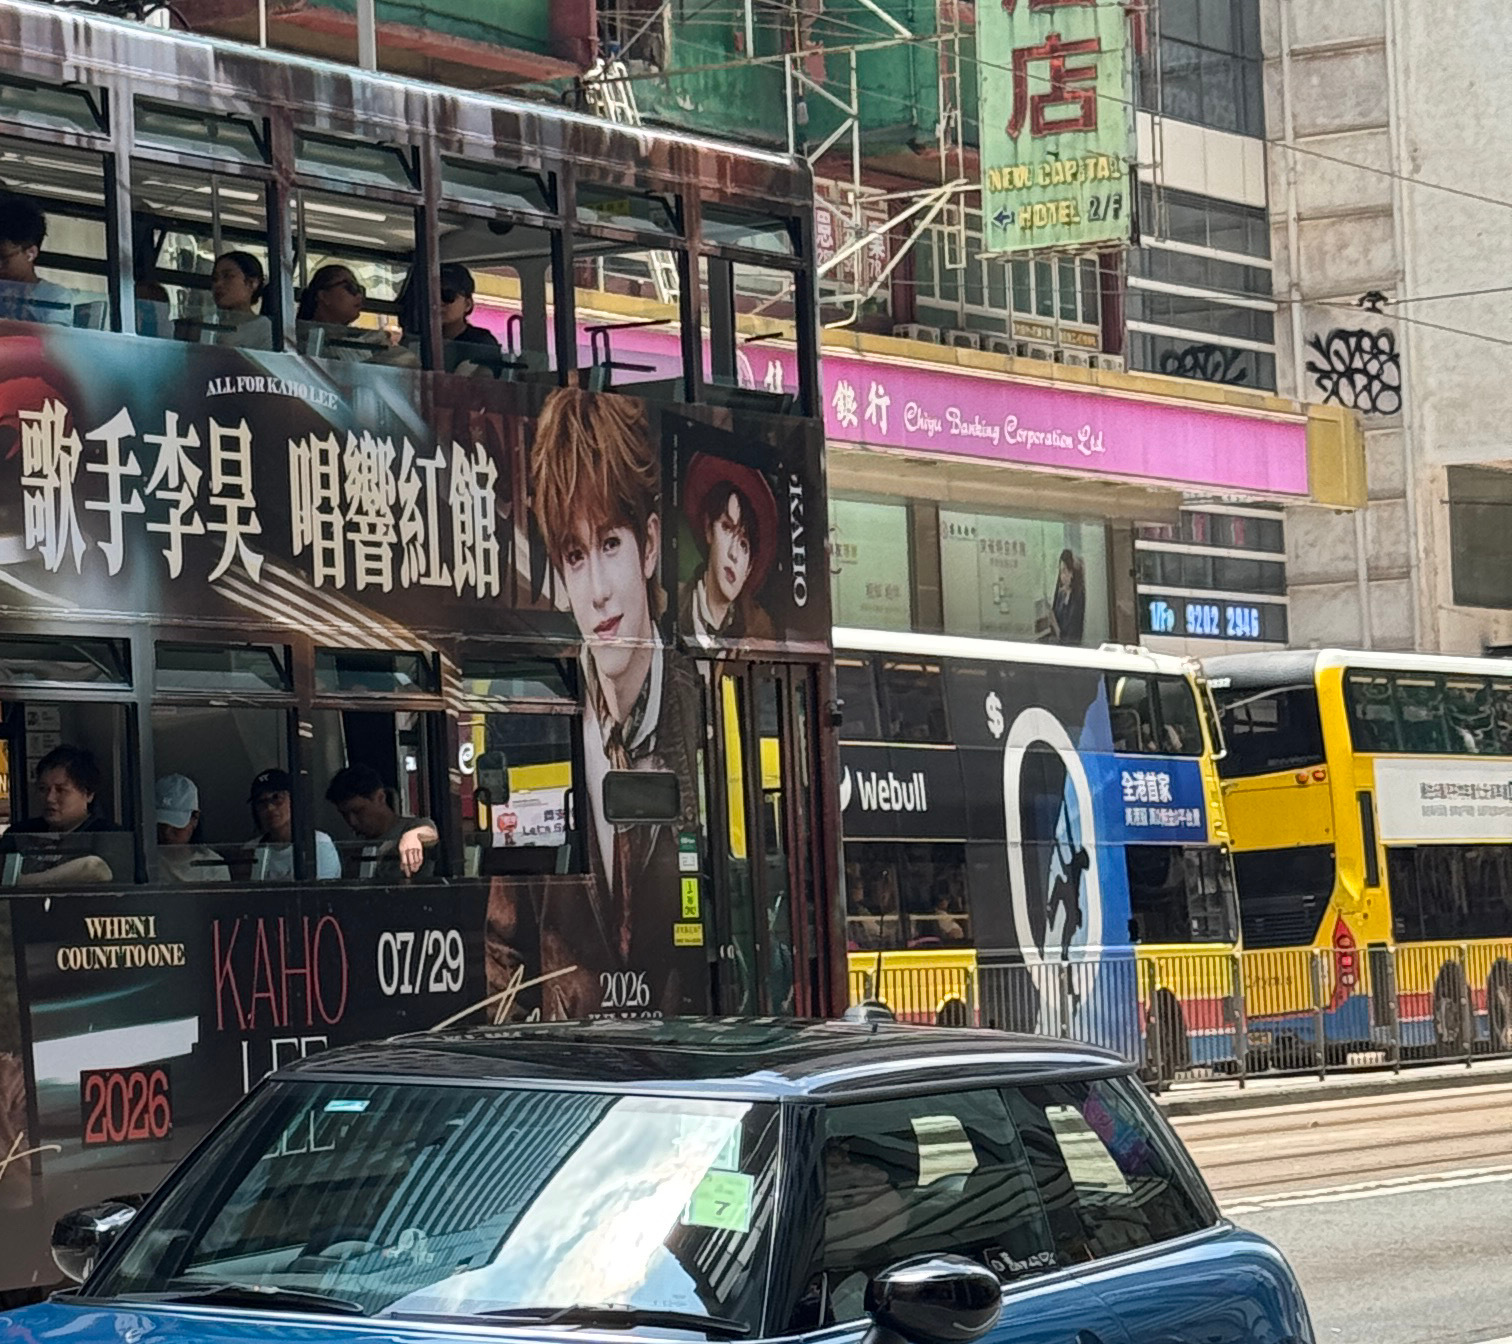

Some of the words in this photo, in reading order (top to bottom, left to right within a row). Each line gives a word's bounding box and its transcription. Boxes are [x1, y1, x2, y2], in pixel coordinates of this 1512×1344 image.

[989, 165, 1032, 190] NEW
[1018, 201, 1081, 229] HOTEL
[1089, 193, 1122, 221] 2/F
[206, 377, 236, 397] ALL
[236, 375, 265, 393] FOR
[266, 376, 307, 399] KAHO
[308, 385, 338, 411] LEE
[832, 380, 890, 436] 銀行
[903, 401, 943, 438] Chiyu
[945, 407, 1000, 445] Banking
[1003, 415, 1073, 450] Corporation
[18, 397, 266, 584] 歌手李昊
[287, 426, 500, 598] 唱響紅館
[855, 771, 928, 812] Webull
[84, 916, 145, 940] WHEN
[57, 946, 119, 971] COUNT
[122, 945, 145, 968] TO
[147, 943, 186, 967] ONE
[213, 915, 348, 1031] KAHO
[377, 929, 465, 996] 07/29
[599, 972, 650, 1008] 2026
[84, 1070, 172, 1142] 2026
